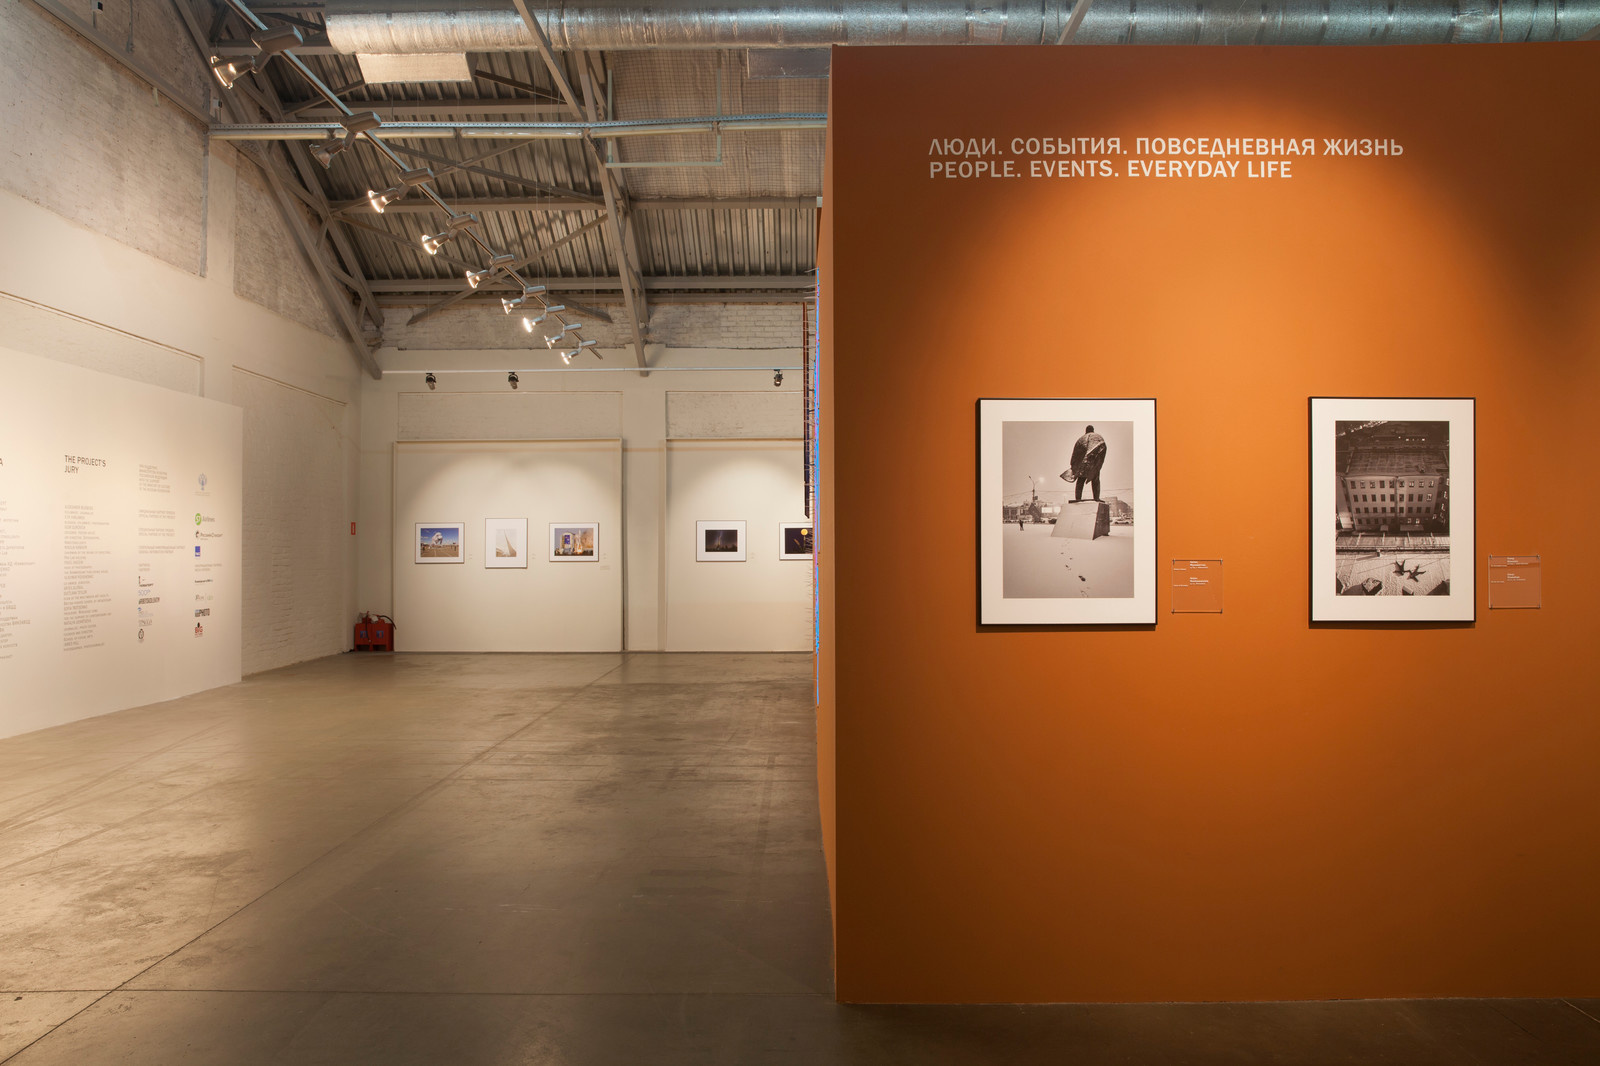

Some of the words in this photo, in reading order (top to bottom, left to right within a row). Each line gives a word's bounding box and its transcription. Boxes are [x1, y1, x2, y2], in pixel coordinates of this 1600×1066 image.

[929, 137, 1002, 158] ЛЮДИ.
[1011, 137, 1127, 155] СОБЫТИЯ.
[1136, 137, 1315, 158] ПОВСЕДНЕВНАЯ
[1323, 138, 1404, 156] ЖИЗНЬ
[929, 160, 1022, 178] PEOPLE.
[1030, 160, 1120, 178] EVENTS.
[1127, 160, 1241, 178] EVERYDAY
[1248, 160, 1293, 178] LIFE
[64, 455, 76, 464] THE
[77, 456, 107, 467] PROJECT'S
[64, 466, 79, 474] JURY
